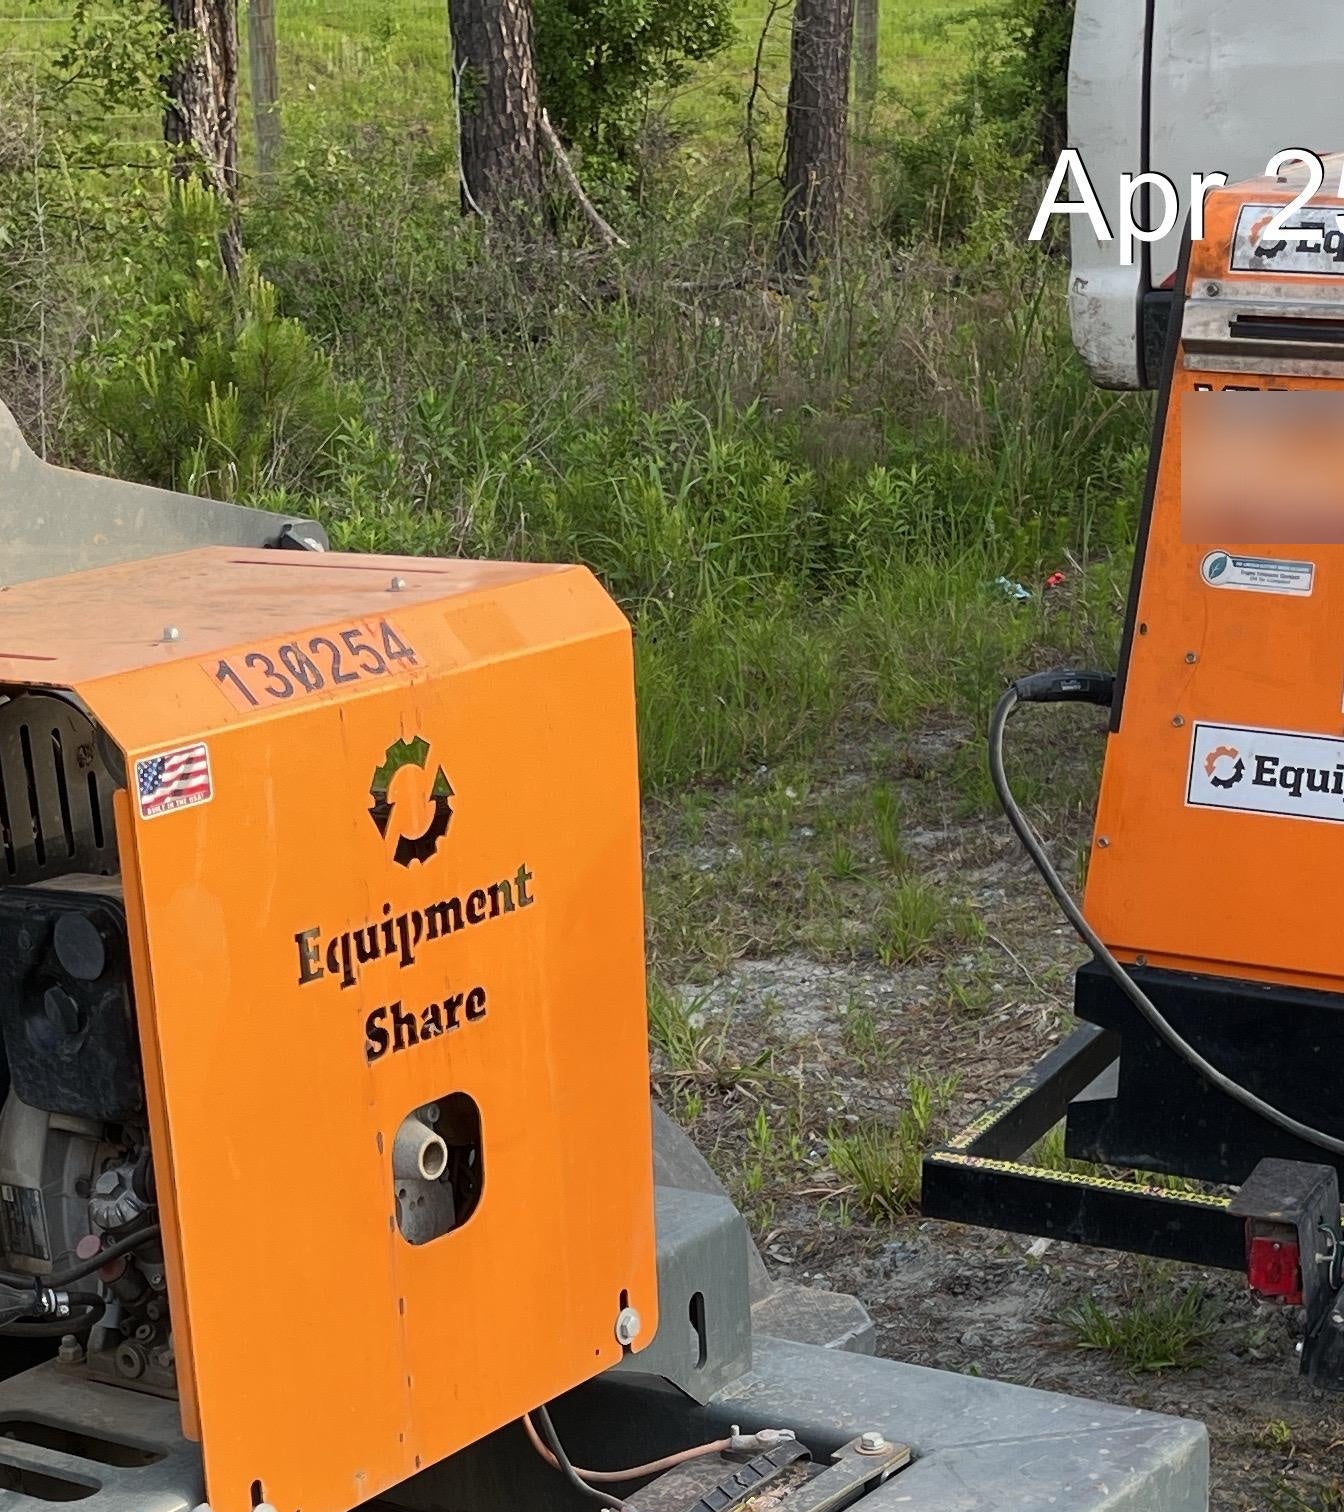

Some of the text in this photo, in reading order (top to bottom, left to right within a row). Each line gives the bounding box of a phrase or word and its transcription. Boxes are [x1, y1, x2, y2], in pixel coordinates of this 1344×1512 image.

[215, 619, 419, 706] 130254
[294, 863, 534, 990] Equipment
[365, 987, 487, 1063] Share
